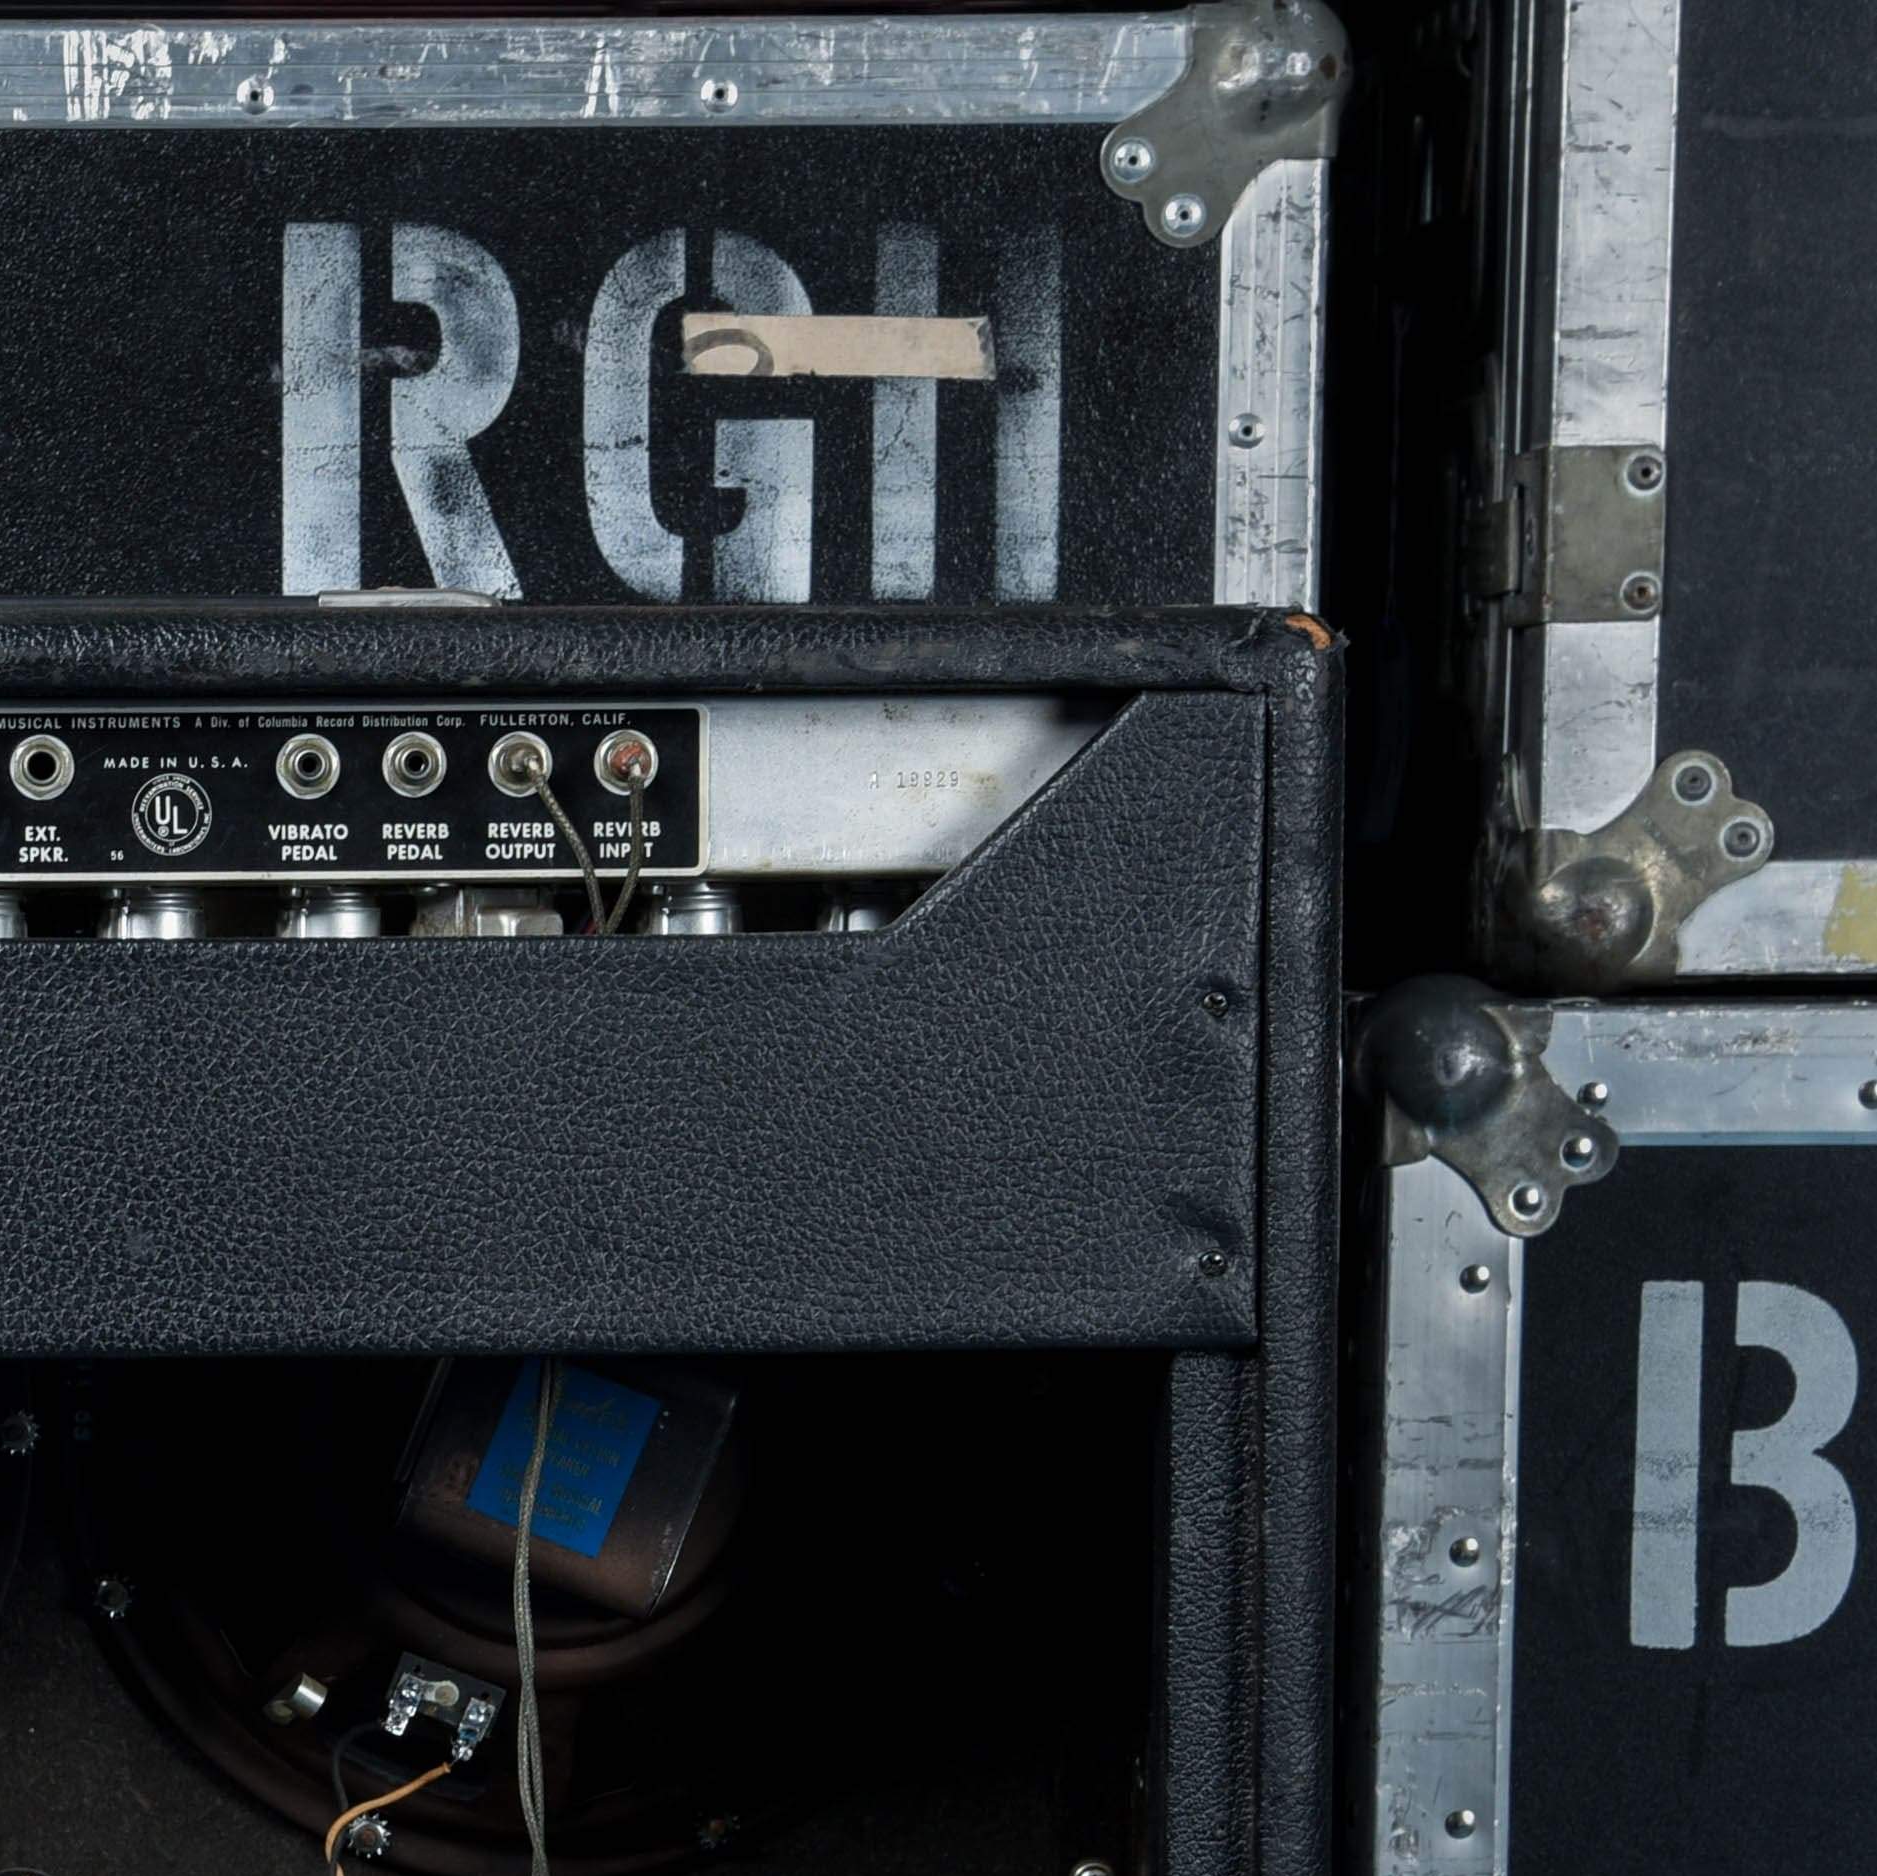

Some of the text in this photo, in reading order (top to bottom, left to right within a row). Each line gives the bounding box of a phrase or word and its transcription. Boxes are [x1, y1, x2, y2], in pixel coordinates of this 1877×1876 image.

[72, 717, 181, 729] INSTRUMENTS
[195, 717, 202, 728] A
[211, 717, 230, 728] Div.
[238, 716, 250, 728] of
[258, 716, 308, 728] Columbia
[316, 716, 354, 727] Record
[362, 716, 429, 727] Distribution
[437, 715, 465, 728] Corp.
[480, 713, 575, 727] FULLERTON,
[582, 712, 631, 726] CALIF.
[104, 756, 149, 769] MADE
[160, 757, 177, 768] IN
[155, 795, 188, 835] UL
[25, 826, 60, 841] EXT.
[268, 824, 348, 840] VIBRATO
[382, 823, 449, 839] REVERB
[488, 822, 555, 838] REVERB
[19, 848, 68, 863] SPKR.
[281, 845, 337, 861] PEDAL
[387, 844, 443, 860] PEDAL
[485, 843, 556, 859] OUTPUT
[599, 842, 654, 858] INPT
[1630, 1280, 1858, 1650] B
